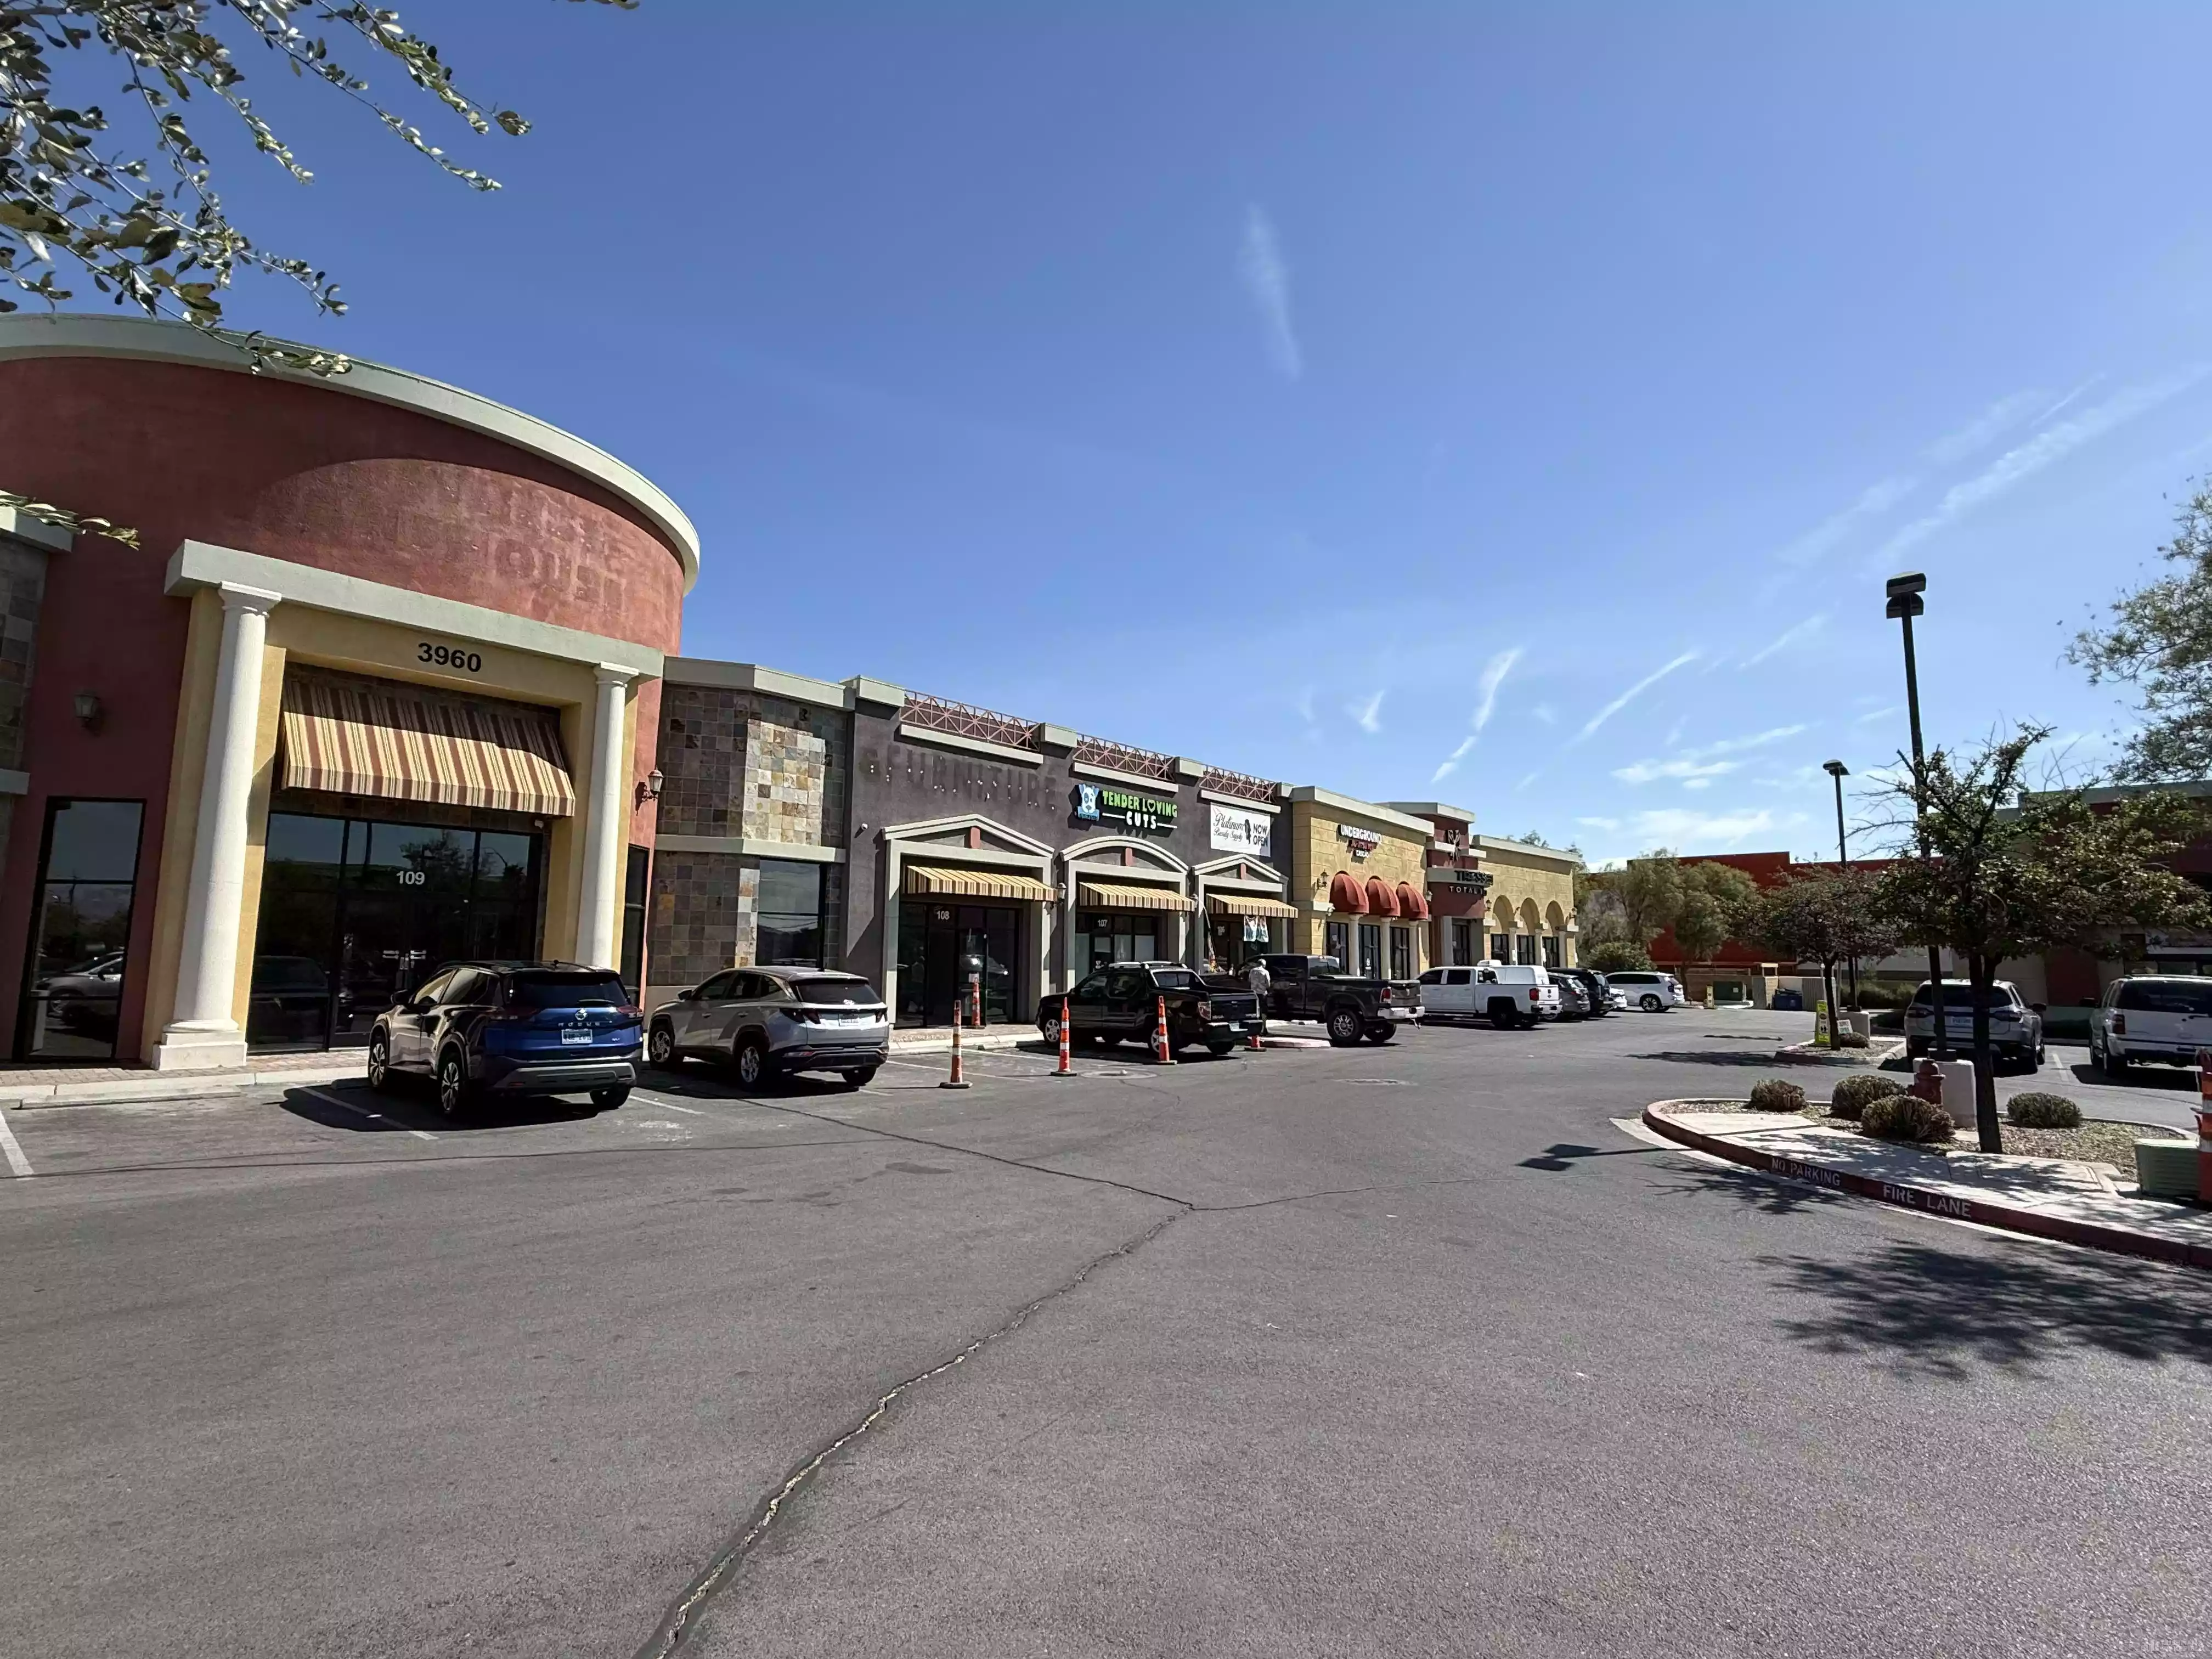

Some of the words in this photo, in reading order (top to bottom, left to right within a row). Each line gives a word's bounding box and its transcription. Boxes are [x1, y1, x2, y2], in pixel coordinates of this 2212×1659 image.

[417, 642, 482, 672] 3960
[1102, 790, 1140, 810] TENDER
[1142, 798, 1178, 817] LOVING
[1126, 811, 1156, 829] CUTS
[1214, 812, 1244, 831] Platinum
[1253, 823, 1268, 836] NOW
[1341, 824, 1381, 843] UNDERGROUND
[1253, 835, 1268, 847] OPEN
[396, 871, 425, 885] 109
[1449, 886, 1477, 894] TOTAL
[936, 911, 950, 920] 108
[1097, 919, 1108, 927] 107
[1771, 1157, 1785, 1171] NO
[1790, 1163, 1841, 1186] PARKING
[1883, 1184, 1916, 1204] FIRE
[1927, 1194, 1972, 1218] LANE
